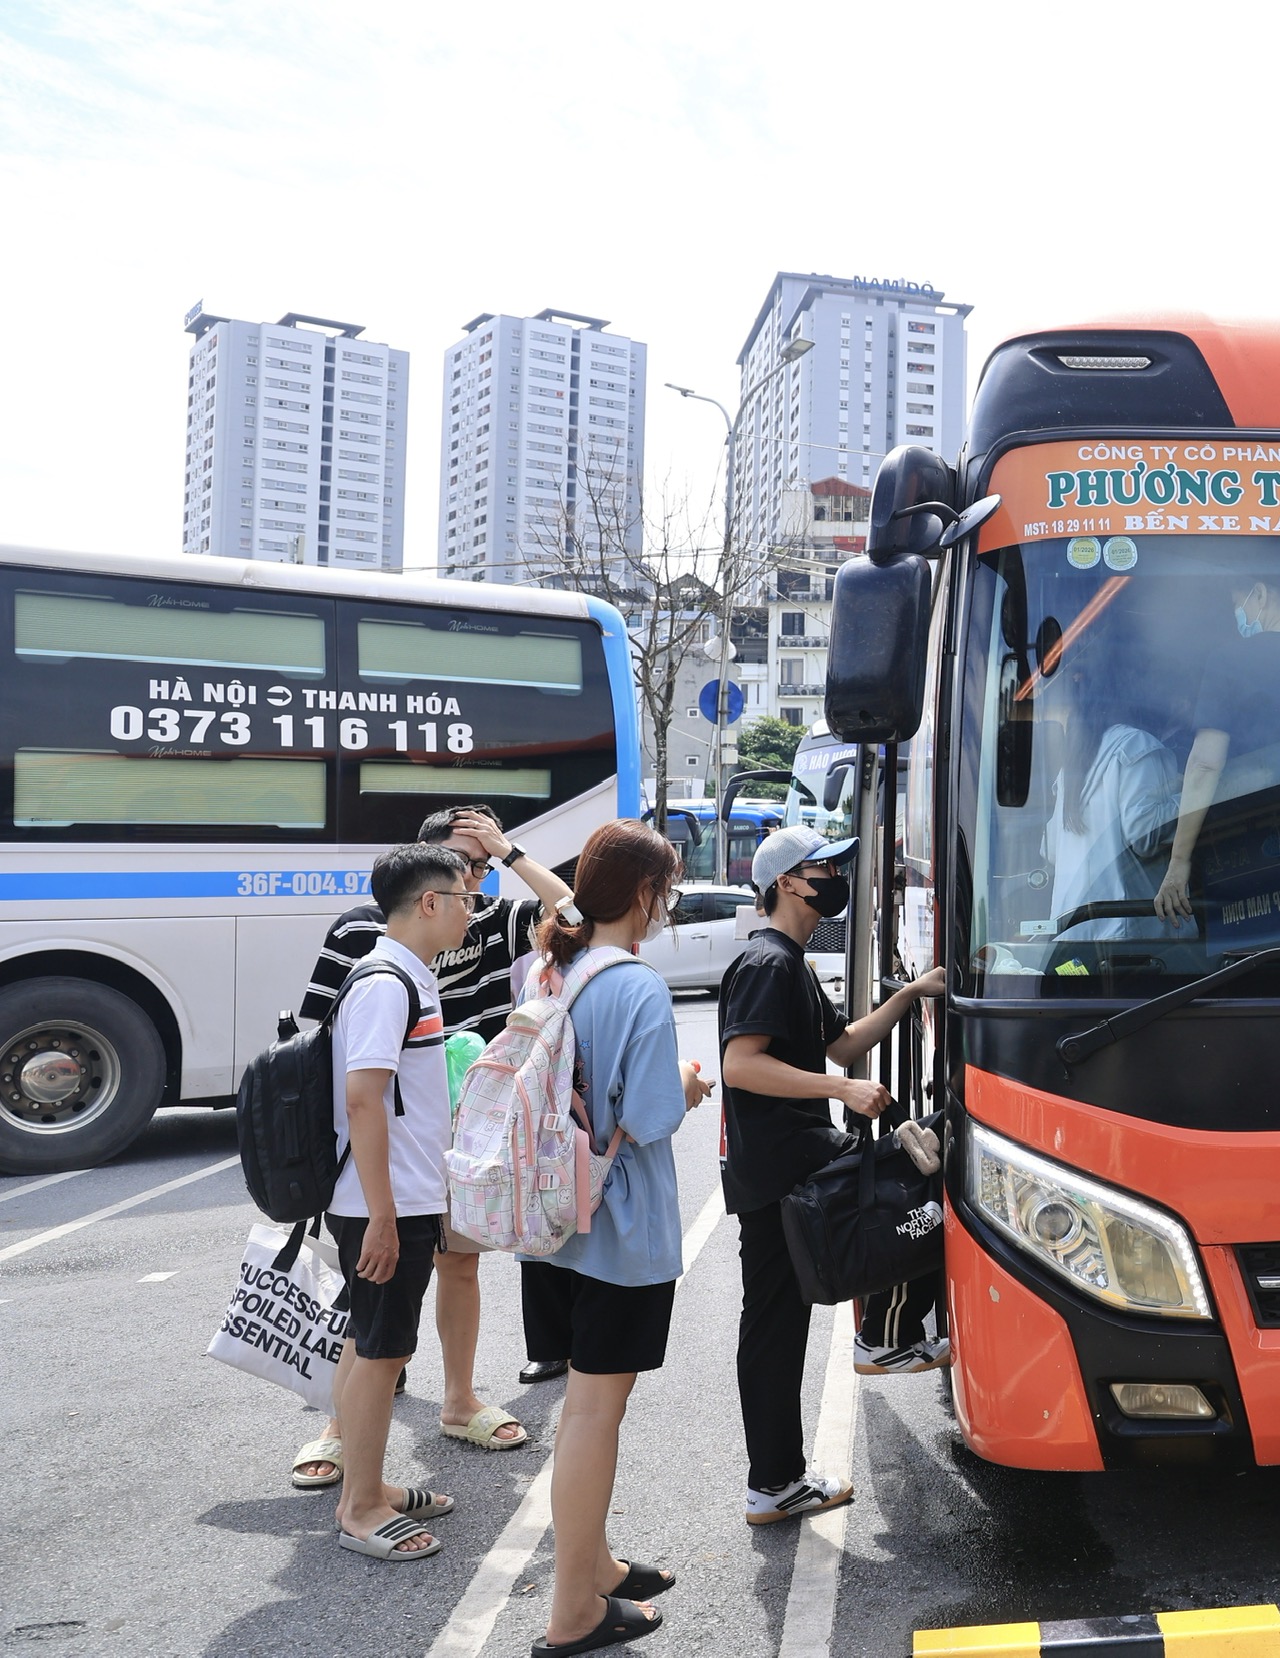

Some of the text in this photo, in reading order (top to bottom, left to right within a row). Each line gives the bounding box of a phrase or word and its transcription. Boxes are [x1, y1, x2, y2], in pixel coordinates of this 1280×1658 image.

[853, 275, 899, 292] NAM
[1078, 443, 1144, 462] CÔNG
[1149, 447, 1178, 461] TY
[1184, 444, 1216, 462] CỔ
[1046, 460, 1244, 509] PHƯƠNG
[1024, 518, 1111, 537] MST: 18 29 11 11
[1124, 508, 1189, 532] BẾN
[1198, 515, 1240, 532] XE
[148, 676, 257, 708] HÀ NỘI
[302, 688, 461, 717] THANH HÓA
[110, 705, 474, 754] 0373 116 118
[237, 871, 372, 896] 36F-004.97
[895, 1213, 931, 1235] NORTH
[910, 1220, 934, 1240] FACE
